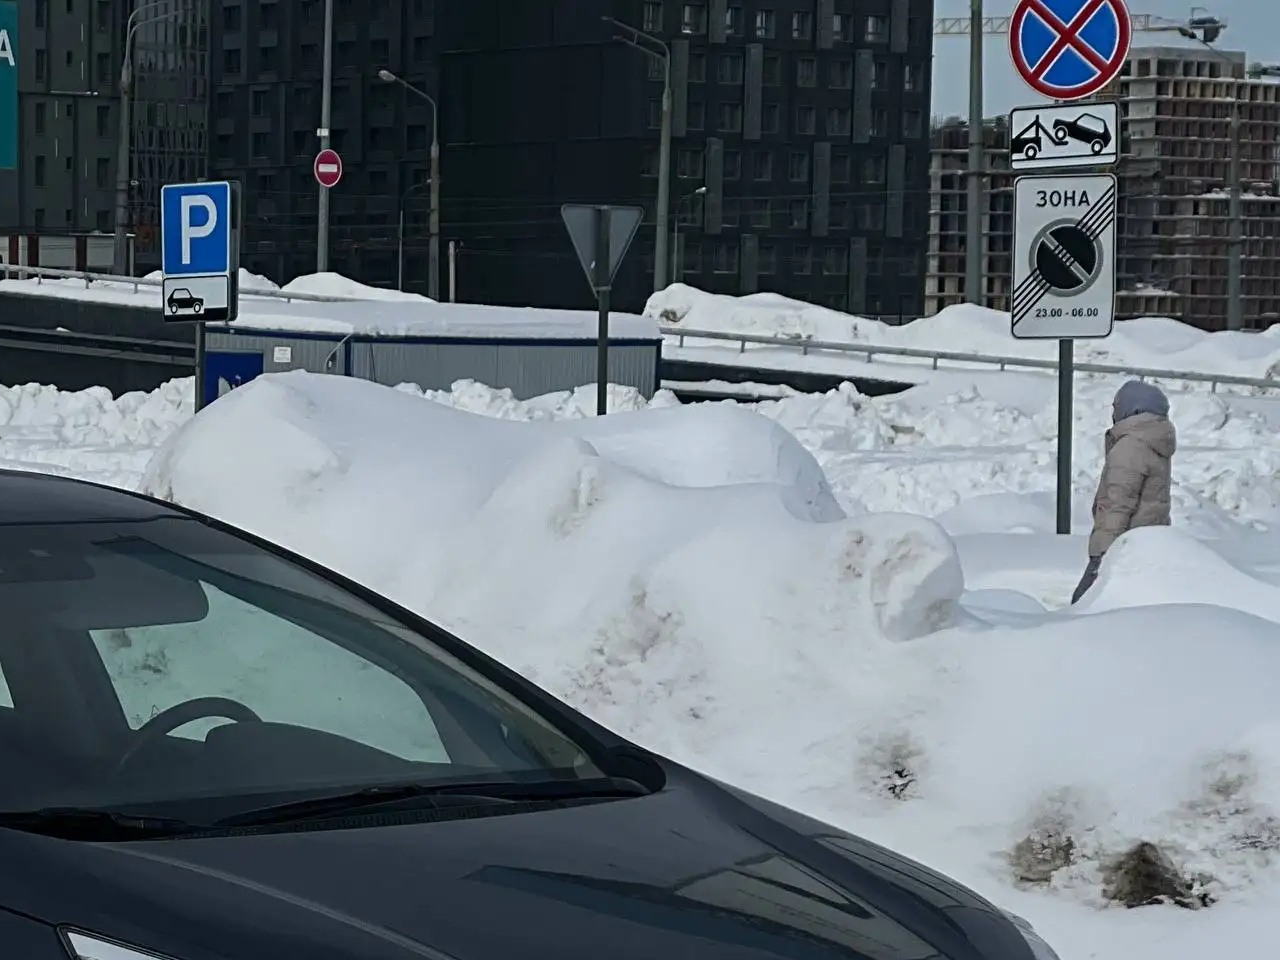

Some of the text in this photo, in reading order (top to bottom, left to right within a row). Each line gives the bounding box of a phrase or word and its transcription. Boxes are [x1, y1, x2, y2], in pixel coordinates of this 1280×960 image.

[1036, 190, 1091, 207] ЗОНА
[181, 194, 218, 265] P
[1035, 308, 1063, 318] 23.00
[1071, 307, 1099, 317] 06.00
